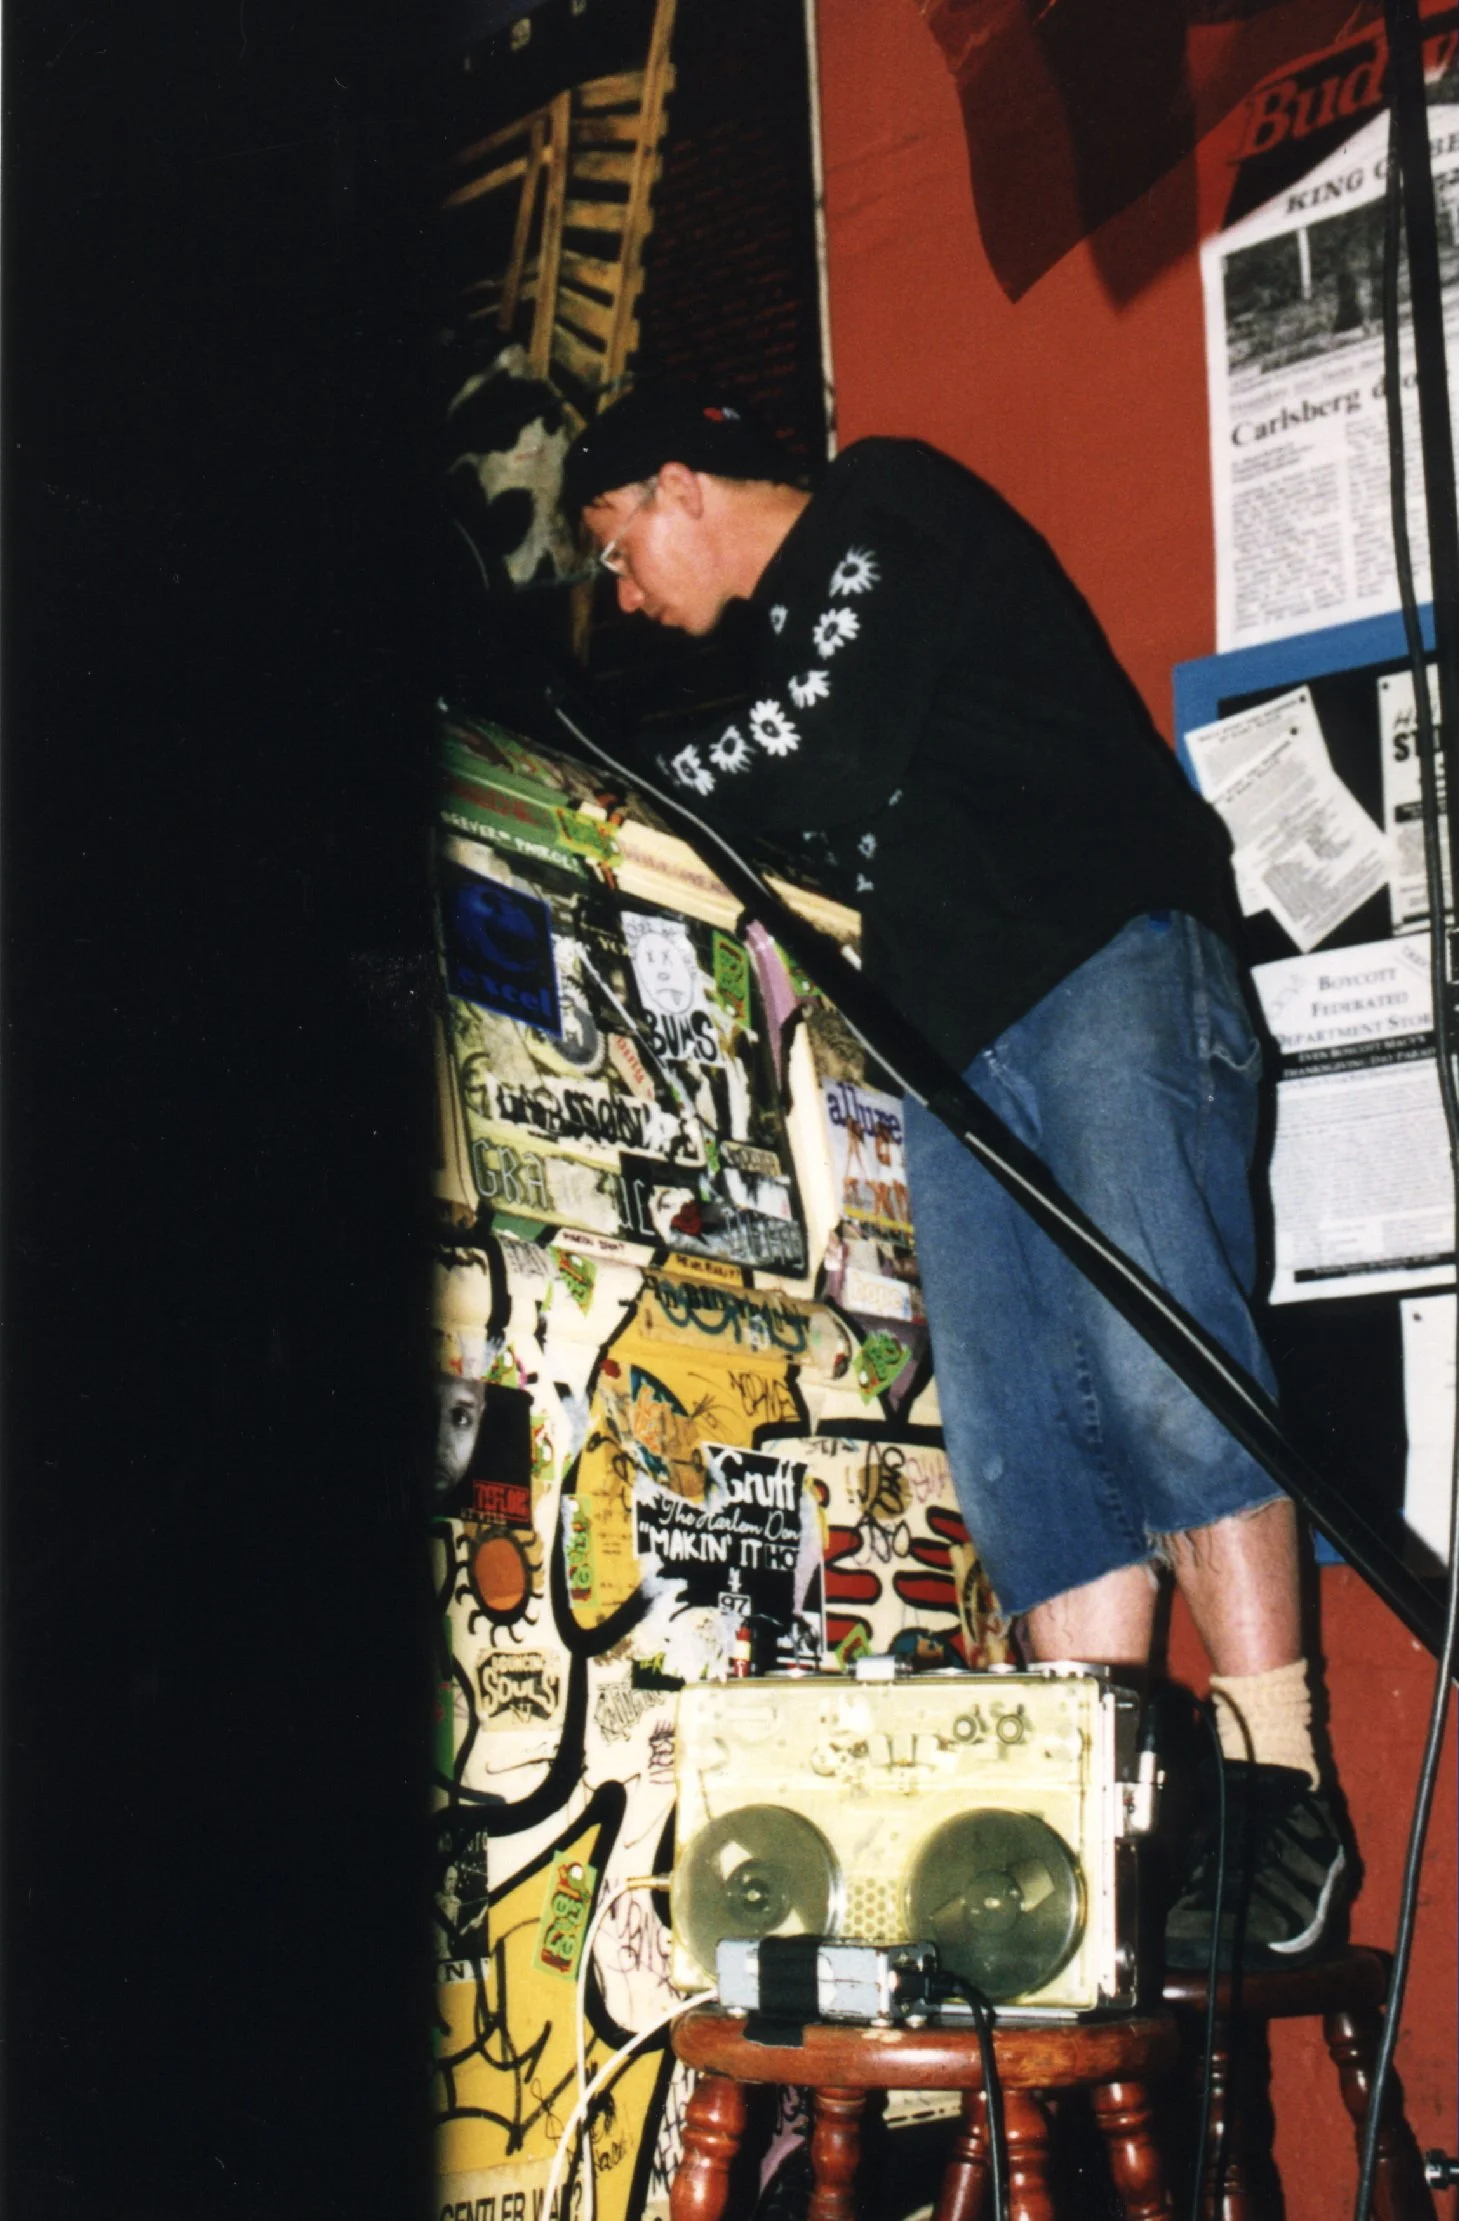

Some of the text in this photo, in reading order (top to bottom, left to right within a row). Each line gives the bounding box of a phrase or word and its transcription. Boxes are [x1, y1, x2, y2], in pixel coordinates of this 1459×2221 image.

[1285, 167, 1365, 214] KING
[1231, 388, 1362, 447] Carlsberg
[827, 1079, 904, 1144] allure
[740, 1539, 764, 1570] IT
